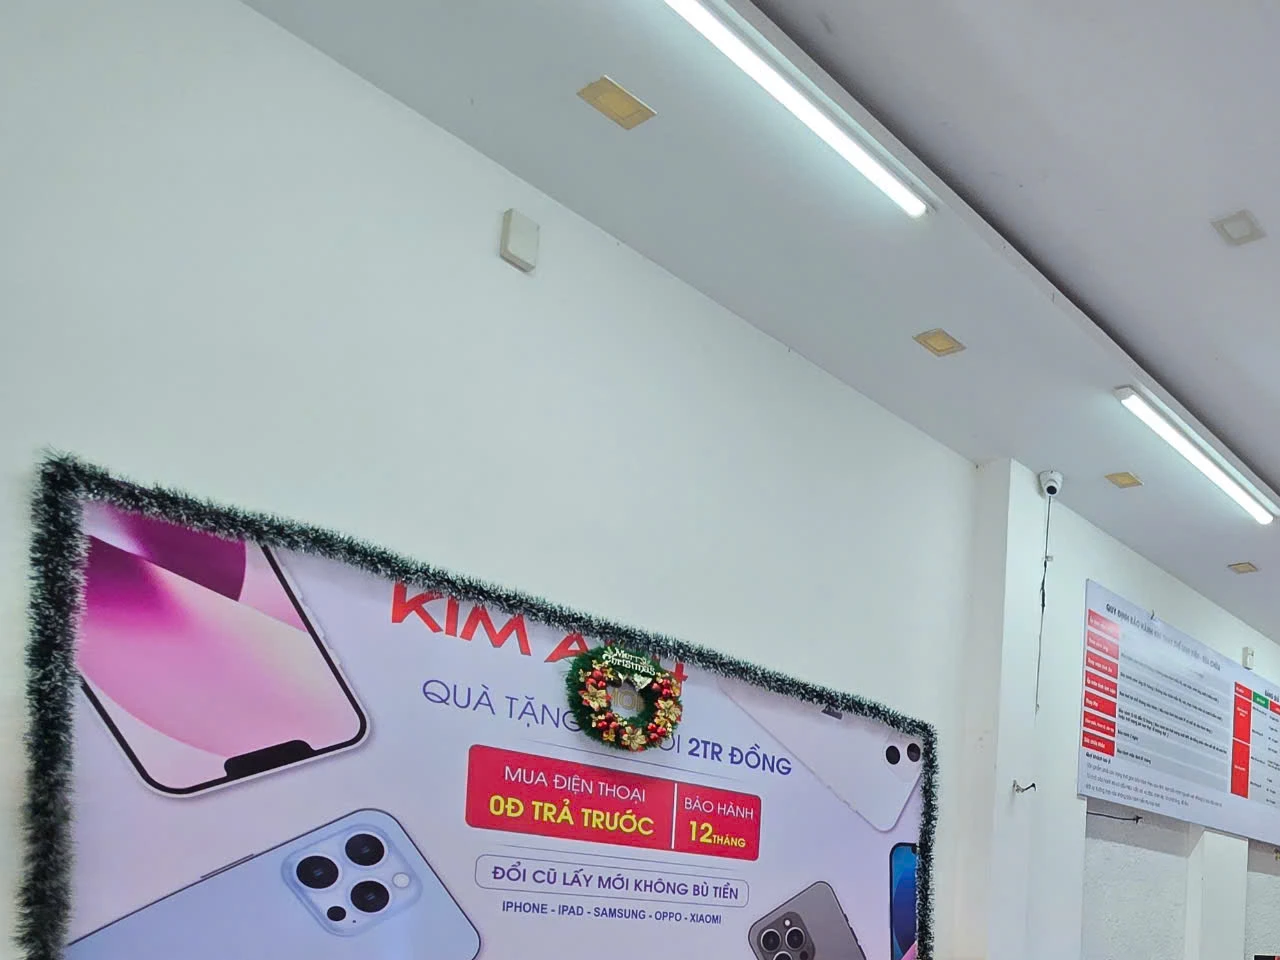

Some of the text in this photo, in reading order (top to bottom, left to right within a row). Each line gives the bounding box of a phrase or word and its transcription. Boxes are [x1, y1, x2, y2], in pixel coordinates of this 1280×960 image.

[391, 581, 532, 656] KIM
[602, 653, 655, 676] Christmas
[614, 647, 647, 665] Merry
[422, 679, 496, 715] QUÀ
[505, 695, 582, 732] TẶNG
[688, 737, 722, 762] 2TR
[729, 743, 792, 775] ĐỒNG
[504, 765, 646, 805] MUA ĐIỆN THOẠI
[531, 798, 574, 826] TRẢ
[581, 806, 655, 837] TRƯỚC
[684, 796, 754, 820] BẢO HÀNH
[491, 861, 739, 901] ĐỔI CŨ LẤY MỚI KHÔNG BÙ TIỀN
[502, 900, 722, 925] IPHONE IPAD SAMSUNG OPPO XIAOMI
